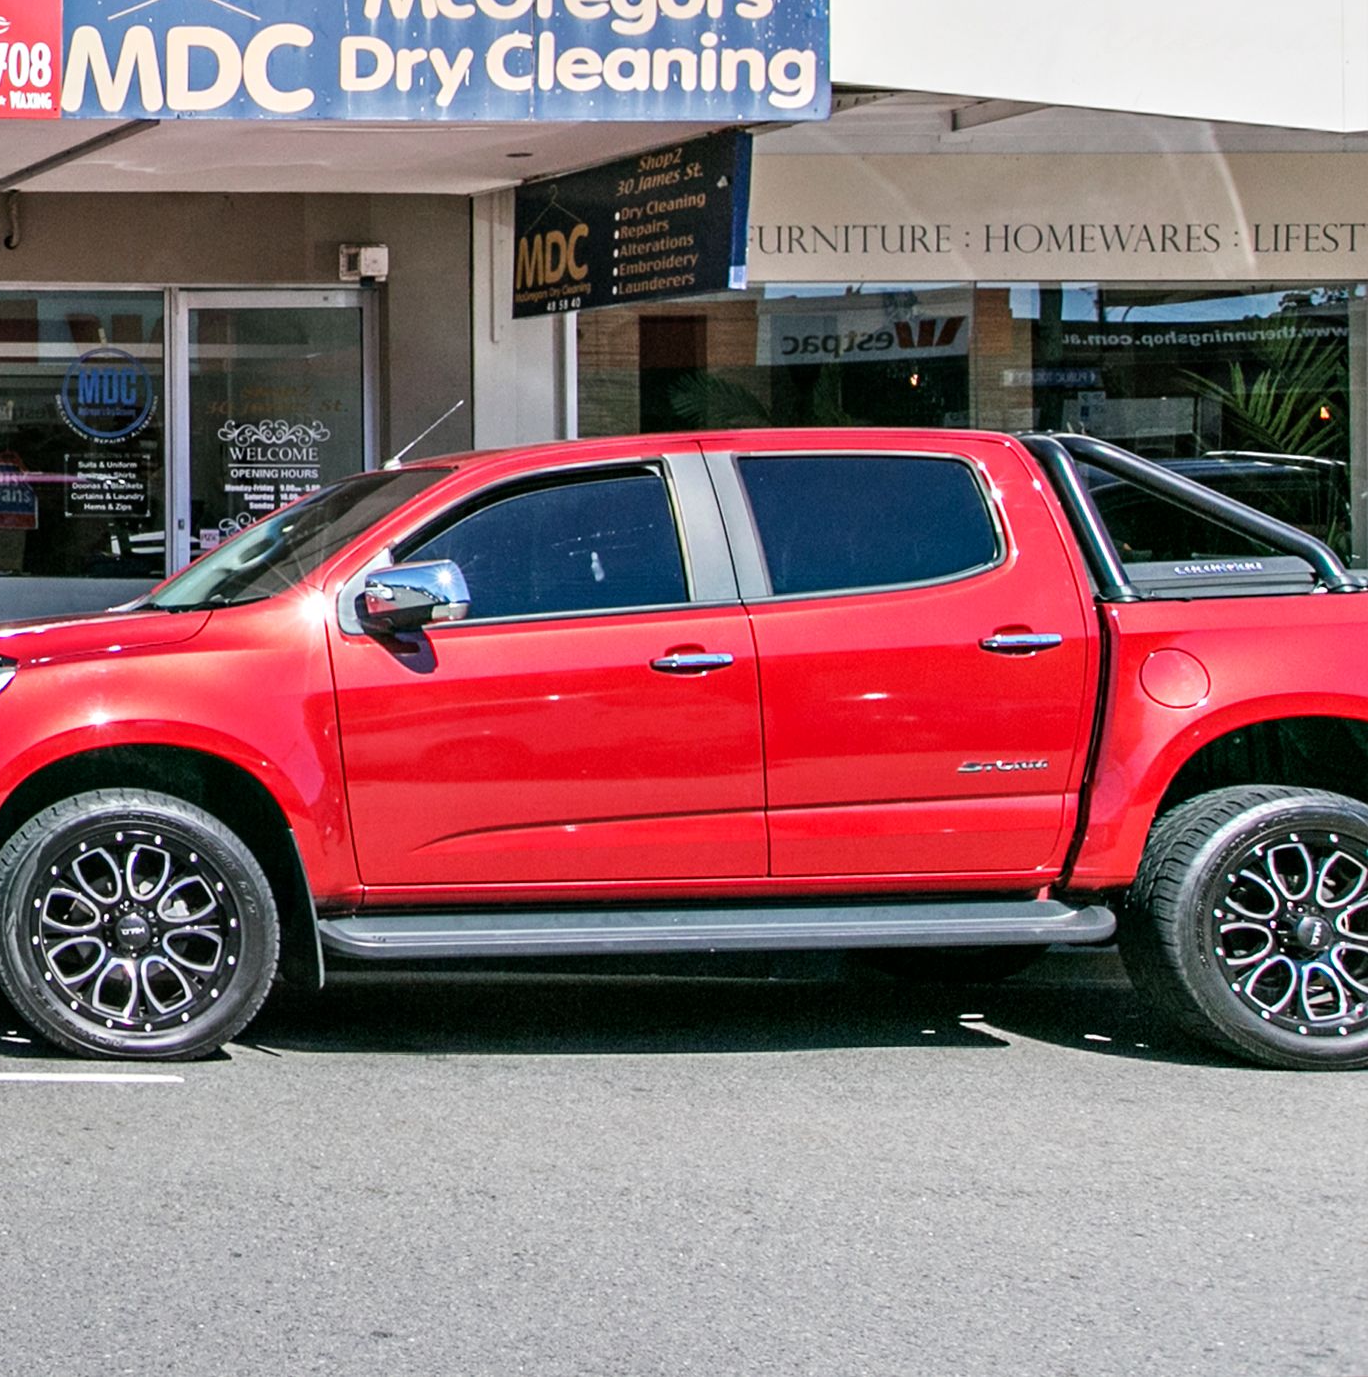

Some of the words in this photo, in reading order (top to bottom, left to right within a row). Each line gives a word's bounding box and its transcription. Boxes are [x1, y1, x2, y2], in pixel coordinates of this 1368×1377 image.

[61, 23, 315, 114] MDC
[340, 35, 474, 107] Dry
[486, 31, 816, 110] Cleaning
[10, 91, 52, 110] WAXING
[616, 177, 634, 197] 30
[635, 169, 680, 195] James
[685, 161, 704, 178] St.
[621, 205, 644, 221] Dry
[646, 191, 707, 216] Cleaning
[620, 218, 670, 241] Repairs
[984, 223, 1221, 254] HOMEWARES
[1253, 223, 1368, 253] LIFEST
[516, 223, 589, 289] MDC
[619, 232, 695, 257] Alterations
[619, 252, 699, 276] Embroidery
[618, 272, 696, 296] Launderers
[77, 367, 137, 406] MDC
[77, 461, 97, 469] Suits
[99, 461, 105, 469] &
[106, 461, 137, 469] Uniform
[229, 446, 319, 462] WELCOME
[230, 468, 278, 478] OPENING
[280, 468, 319, 478] HOURS
[71, 492, 104, 500] Curtains
[106, 492, 112, 500] &
[113, 492, 145, 502] Laundry
[84, 503, 106, 511] Hems
[108, 503, 114, 511] &
[115, 503, 132, 512] Zips
